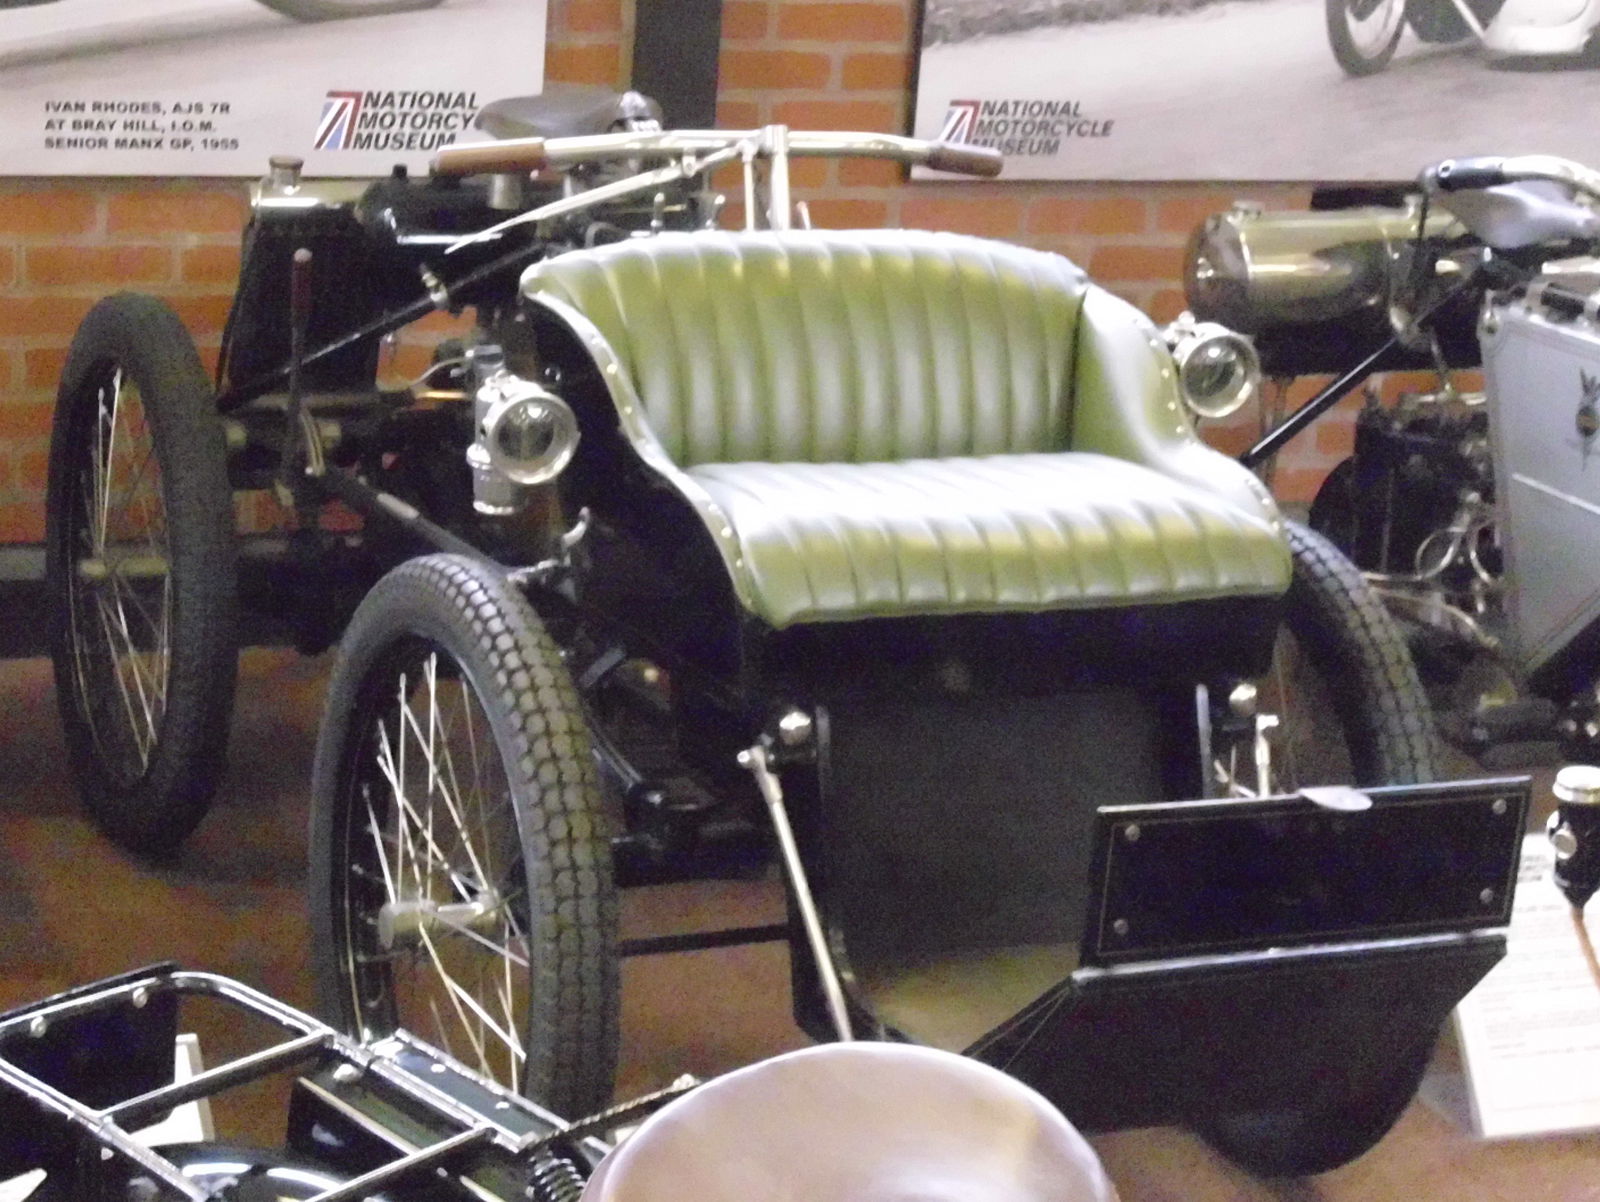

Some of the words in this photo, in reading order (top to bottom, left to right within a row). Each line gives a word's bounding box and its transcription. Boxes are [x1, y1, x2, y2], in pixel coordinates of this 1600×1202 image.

[45, 101, 86, 113] IVAN
[92, 101, 167, 115] RHODES,
[172, 102, 204, 114] AJS
[210, 102, 231, 114] 7R
[363, 91, 478, 110] NATIONAL
[981, 101, 1082, 117] NATIONAL
[44, 119, 65, 131] AT
[71, 119, 116, 132] BRAY
[123, 119, 165, 134] HILL,
[358, 111, 475, 130] MOTORCY
[975, 119, 1115, 137] MOTORCYCLE
[44, 137, 109, 150] SENIOR
[114, 137, 164, 150] MANX
[170, 138, 195, 151] GP,
[201, 138, 239, 150] 1955
[352, 132, 457, 150] MUSEUM
